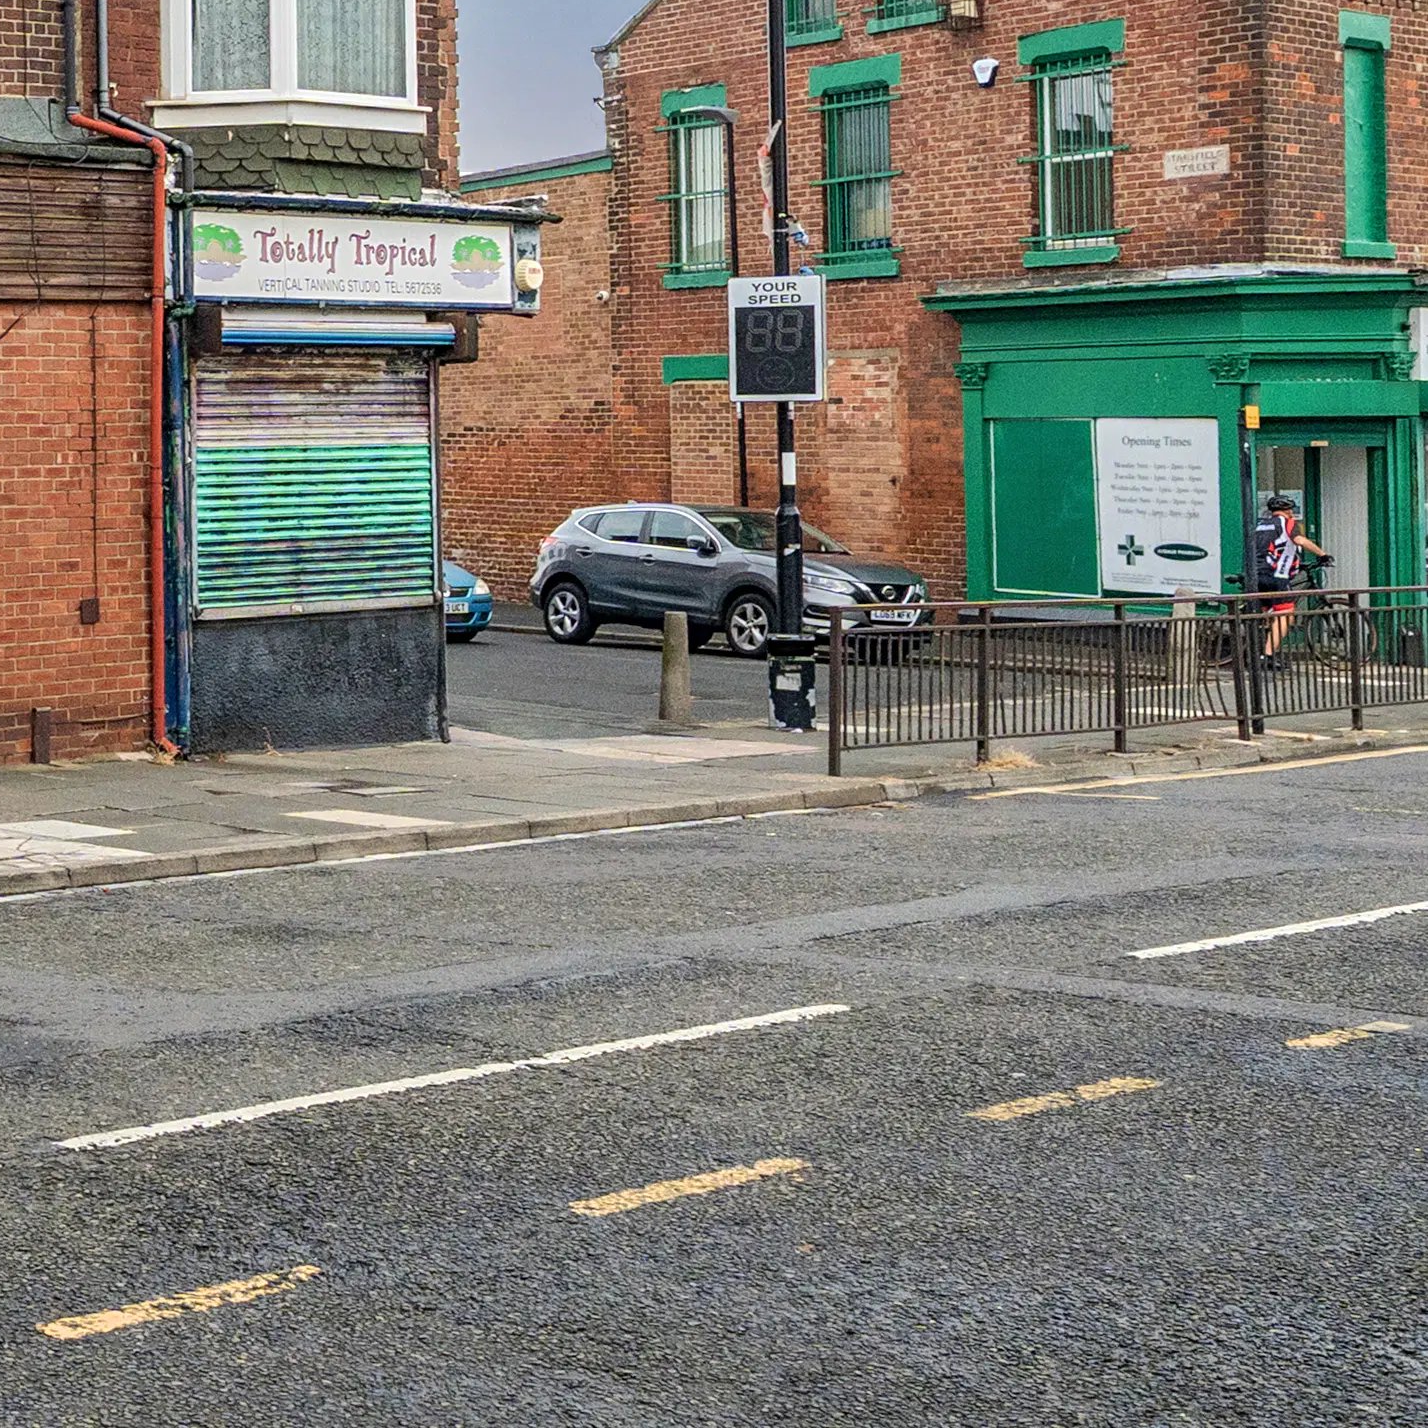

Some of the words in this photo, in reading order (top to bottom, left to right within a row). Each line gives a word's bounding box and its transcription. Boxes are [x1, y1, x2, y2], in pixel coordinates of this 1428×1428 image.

[253, 226, 339, 274] Totally
[349, 229, 437, 276] Tropical
[258, 278, 303, 293] VERTICAL
[304, 278, 345, 293] TANNING
[347, 279, 381, 293] STUDIO
[751, 282, 797, 293] YOUR
[748, 293, 802, 305] SPEED
[1121, 435, 1161, 448] Opening
[1163, 436, 1192, 447] Times
